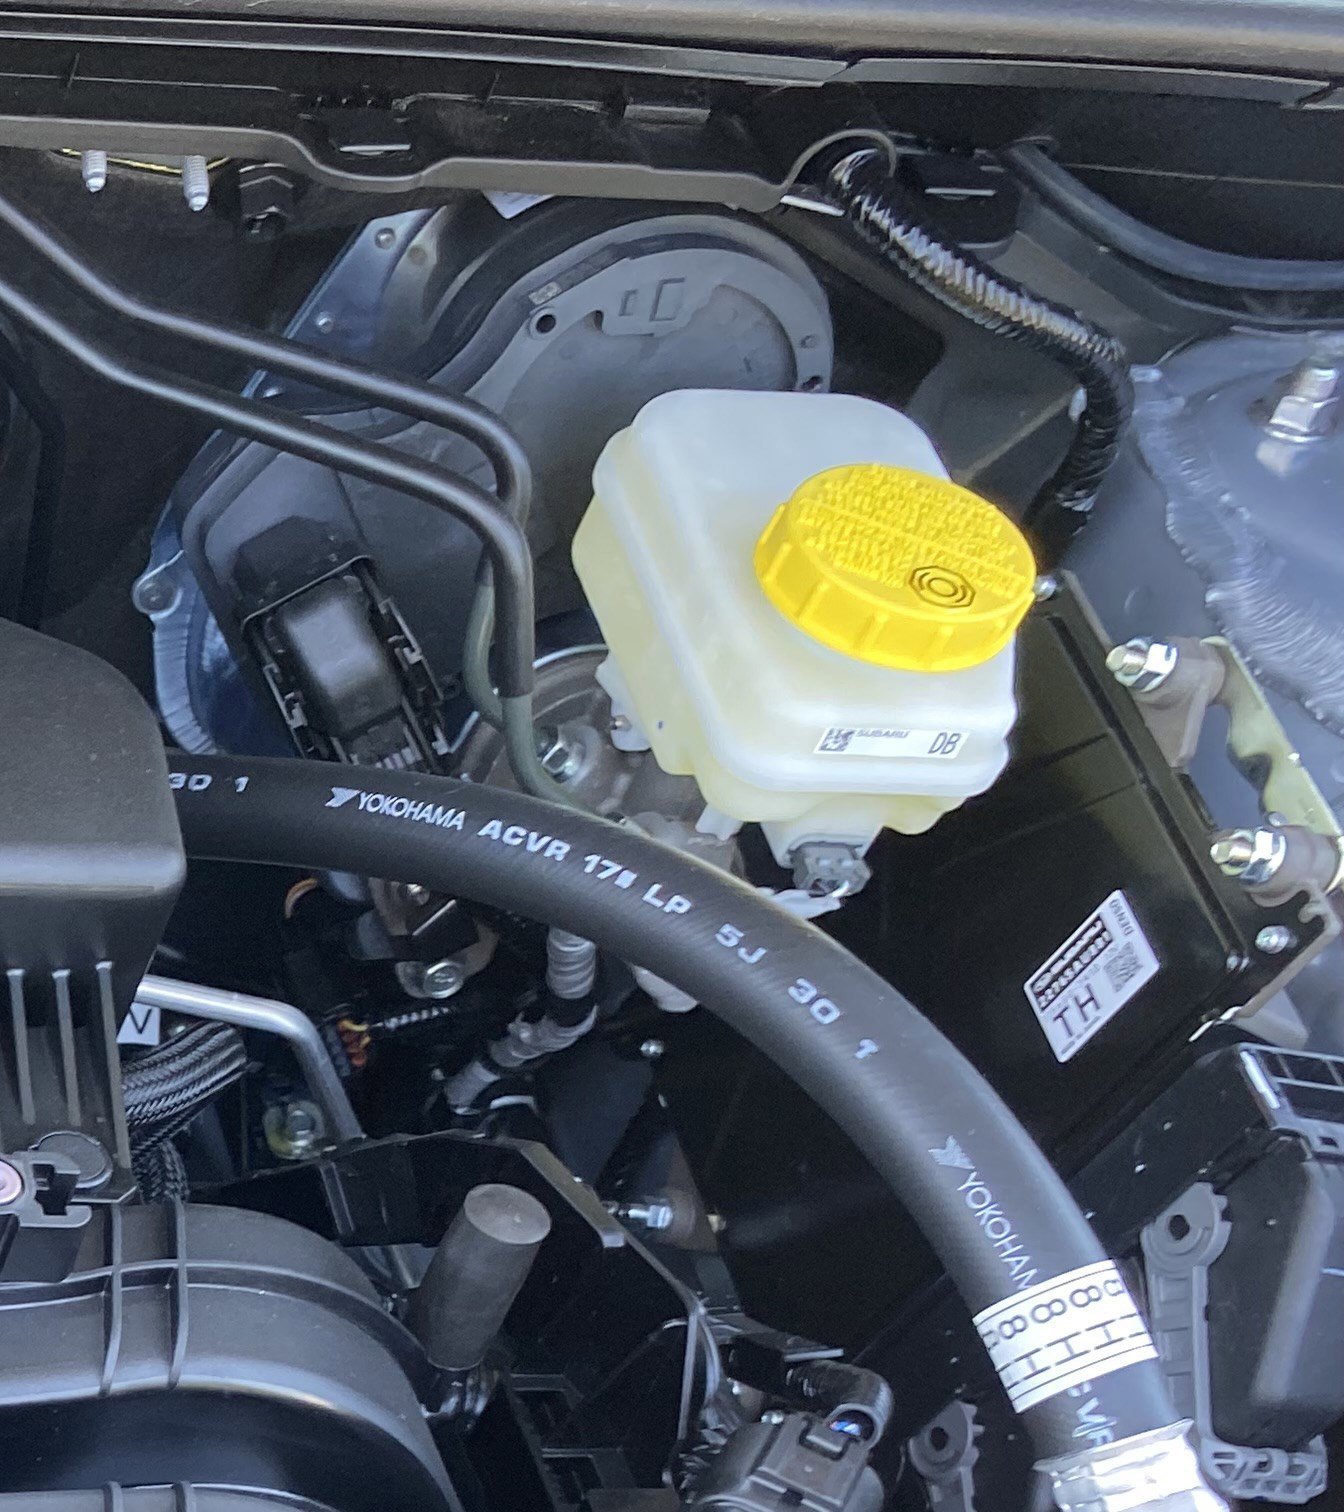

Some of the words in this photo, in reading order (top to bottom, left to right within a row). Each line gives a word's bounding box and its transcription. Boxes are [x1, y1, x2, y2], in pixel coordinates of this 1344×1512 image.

[928, 731, 963, 755] DB
[1053, 983, 1101, 1037] TH
[354, 788, 466, 832] YOKOHAMA
[477, 818, 571, 864] ACVR
[643, 881, 692, 917] LP
[716, 922, 769, 966] 5J
[787, 977, 841, 1026] 30
[957, 1170, 1039, 1292] YOKOHAM
